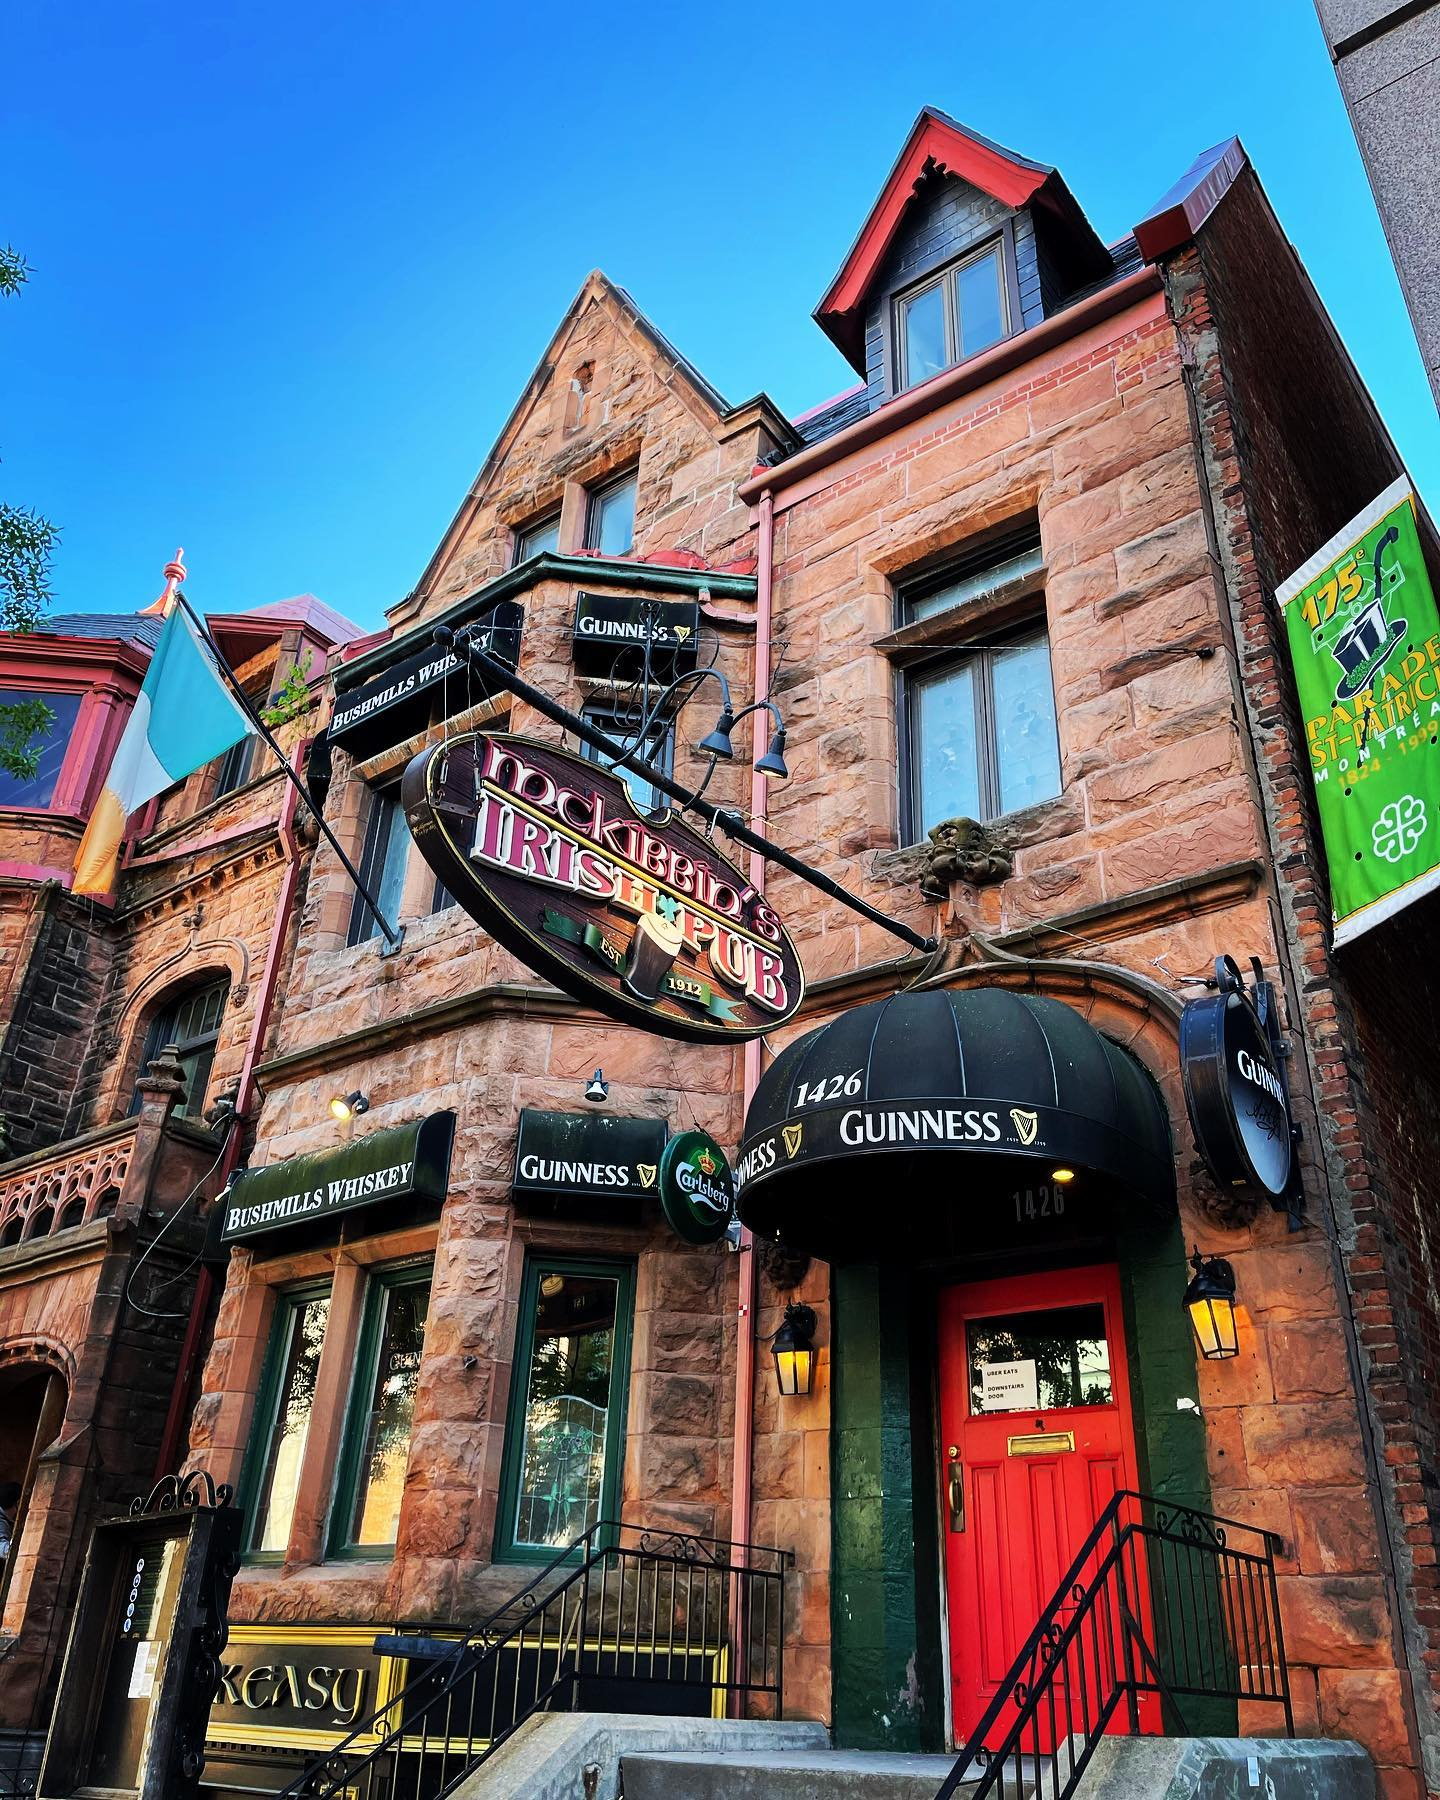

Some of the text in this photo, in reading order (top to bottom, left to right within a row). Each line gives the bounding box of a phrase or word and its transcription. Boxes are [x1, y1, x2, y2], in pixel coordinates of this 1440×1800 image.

[331, 632, 491, 732] BUSHMILLS WHISEY
[1305, 633, 1440, 743] PARADE
[1309, 664, 1440, 769] ST-PATRIC
[1338, 758, 1381, 787] 1824
[1399, 720, 1439, 756] 1999
[469, 789, 660, 917] IRISH
[600, 936, 702, 995] EST 1912
[676, 902, 788, 1013] PUB
[793, 1068, 864, 1109] 1426
[1237, 1050, 1285, 1108] GUINN
[839, 1110, 1001, 1146] GUINNESS
[226, 1162, 413, 1231] BUSHMILLS WHISKEY
[520, 1154, 629, 1186] GUINNESS
[676, 1161, 730, 1212] Carlsberg
[1013, 1184, 1065, 1221] 1426
